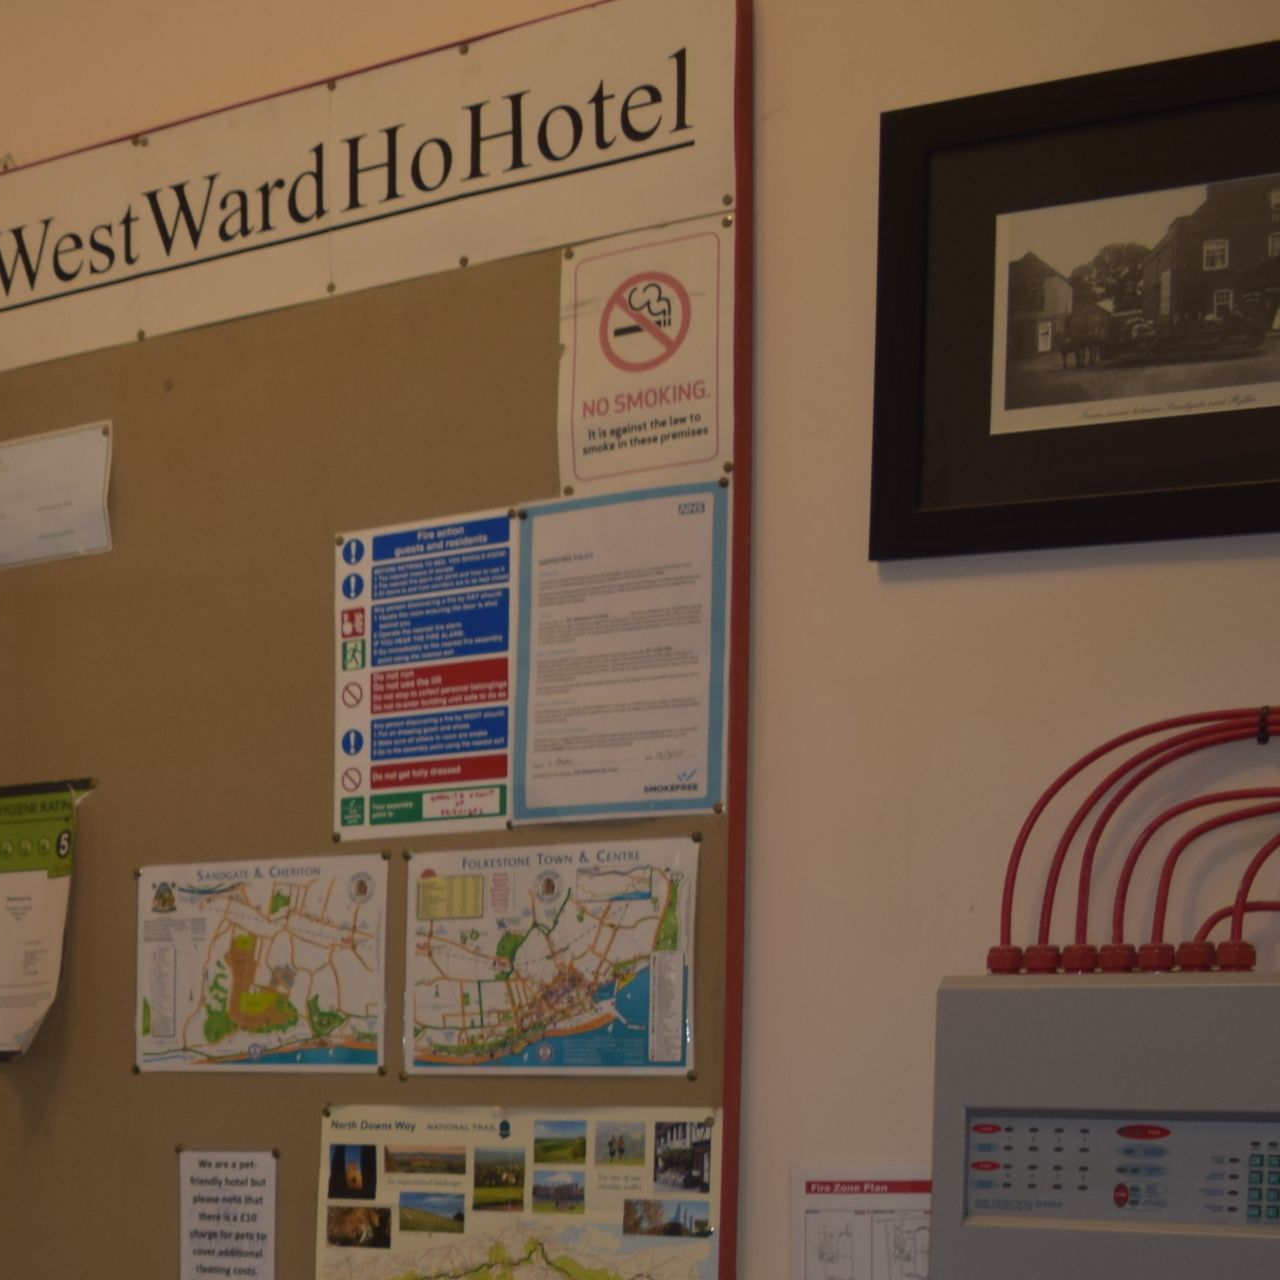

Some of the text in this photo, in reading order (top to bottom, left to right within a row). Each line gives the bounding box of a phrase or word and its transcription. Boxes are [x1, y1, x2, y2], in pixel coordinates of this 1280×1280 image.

[581, 379, 712, 419] NO SMOKING.
[587, 413, 701, 441] It is against the law to
[582, 425, 709, 456] smoke in these premises
[678, 501, 706, 515] NHS
[417, 525, 465, 542] Fire action
[394, 533, 488, 558] guests and residents
[371, 764, 461, 782] Do not get fully dressed
[643, 782, 699, 794] SMOKEFREE
[461, 848, 641, 870] FOLKESTONE TOWN & CENTRE
[196, 864, 321, 881] SANDGATE & CHERITON
[330, 1119, 497, 1134] North Downs Way NATIONAL TRAIL
[198, 1159, 212, 1169] We
[214, 1160, 229, 1169] are
[238, 1160, 258, 1171] pet-
[190, 1176, 267, 1188] friendly hotel but
[810, 1182, 889, 1193] Fire Zone Plan
[192, 1194, 264, 1206] please note that
[198, 1211, 221, 1222] there
[223, 1212, 231, 1222] is
[240, 1212, 258, 1223] £10
[190, 1229, 268, 1242] charge for pets to
[192, 1247, 263, 1259] cover additional
[196, 1263, 259, 1277] cleaning costs.
